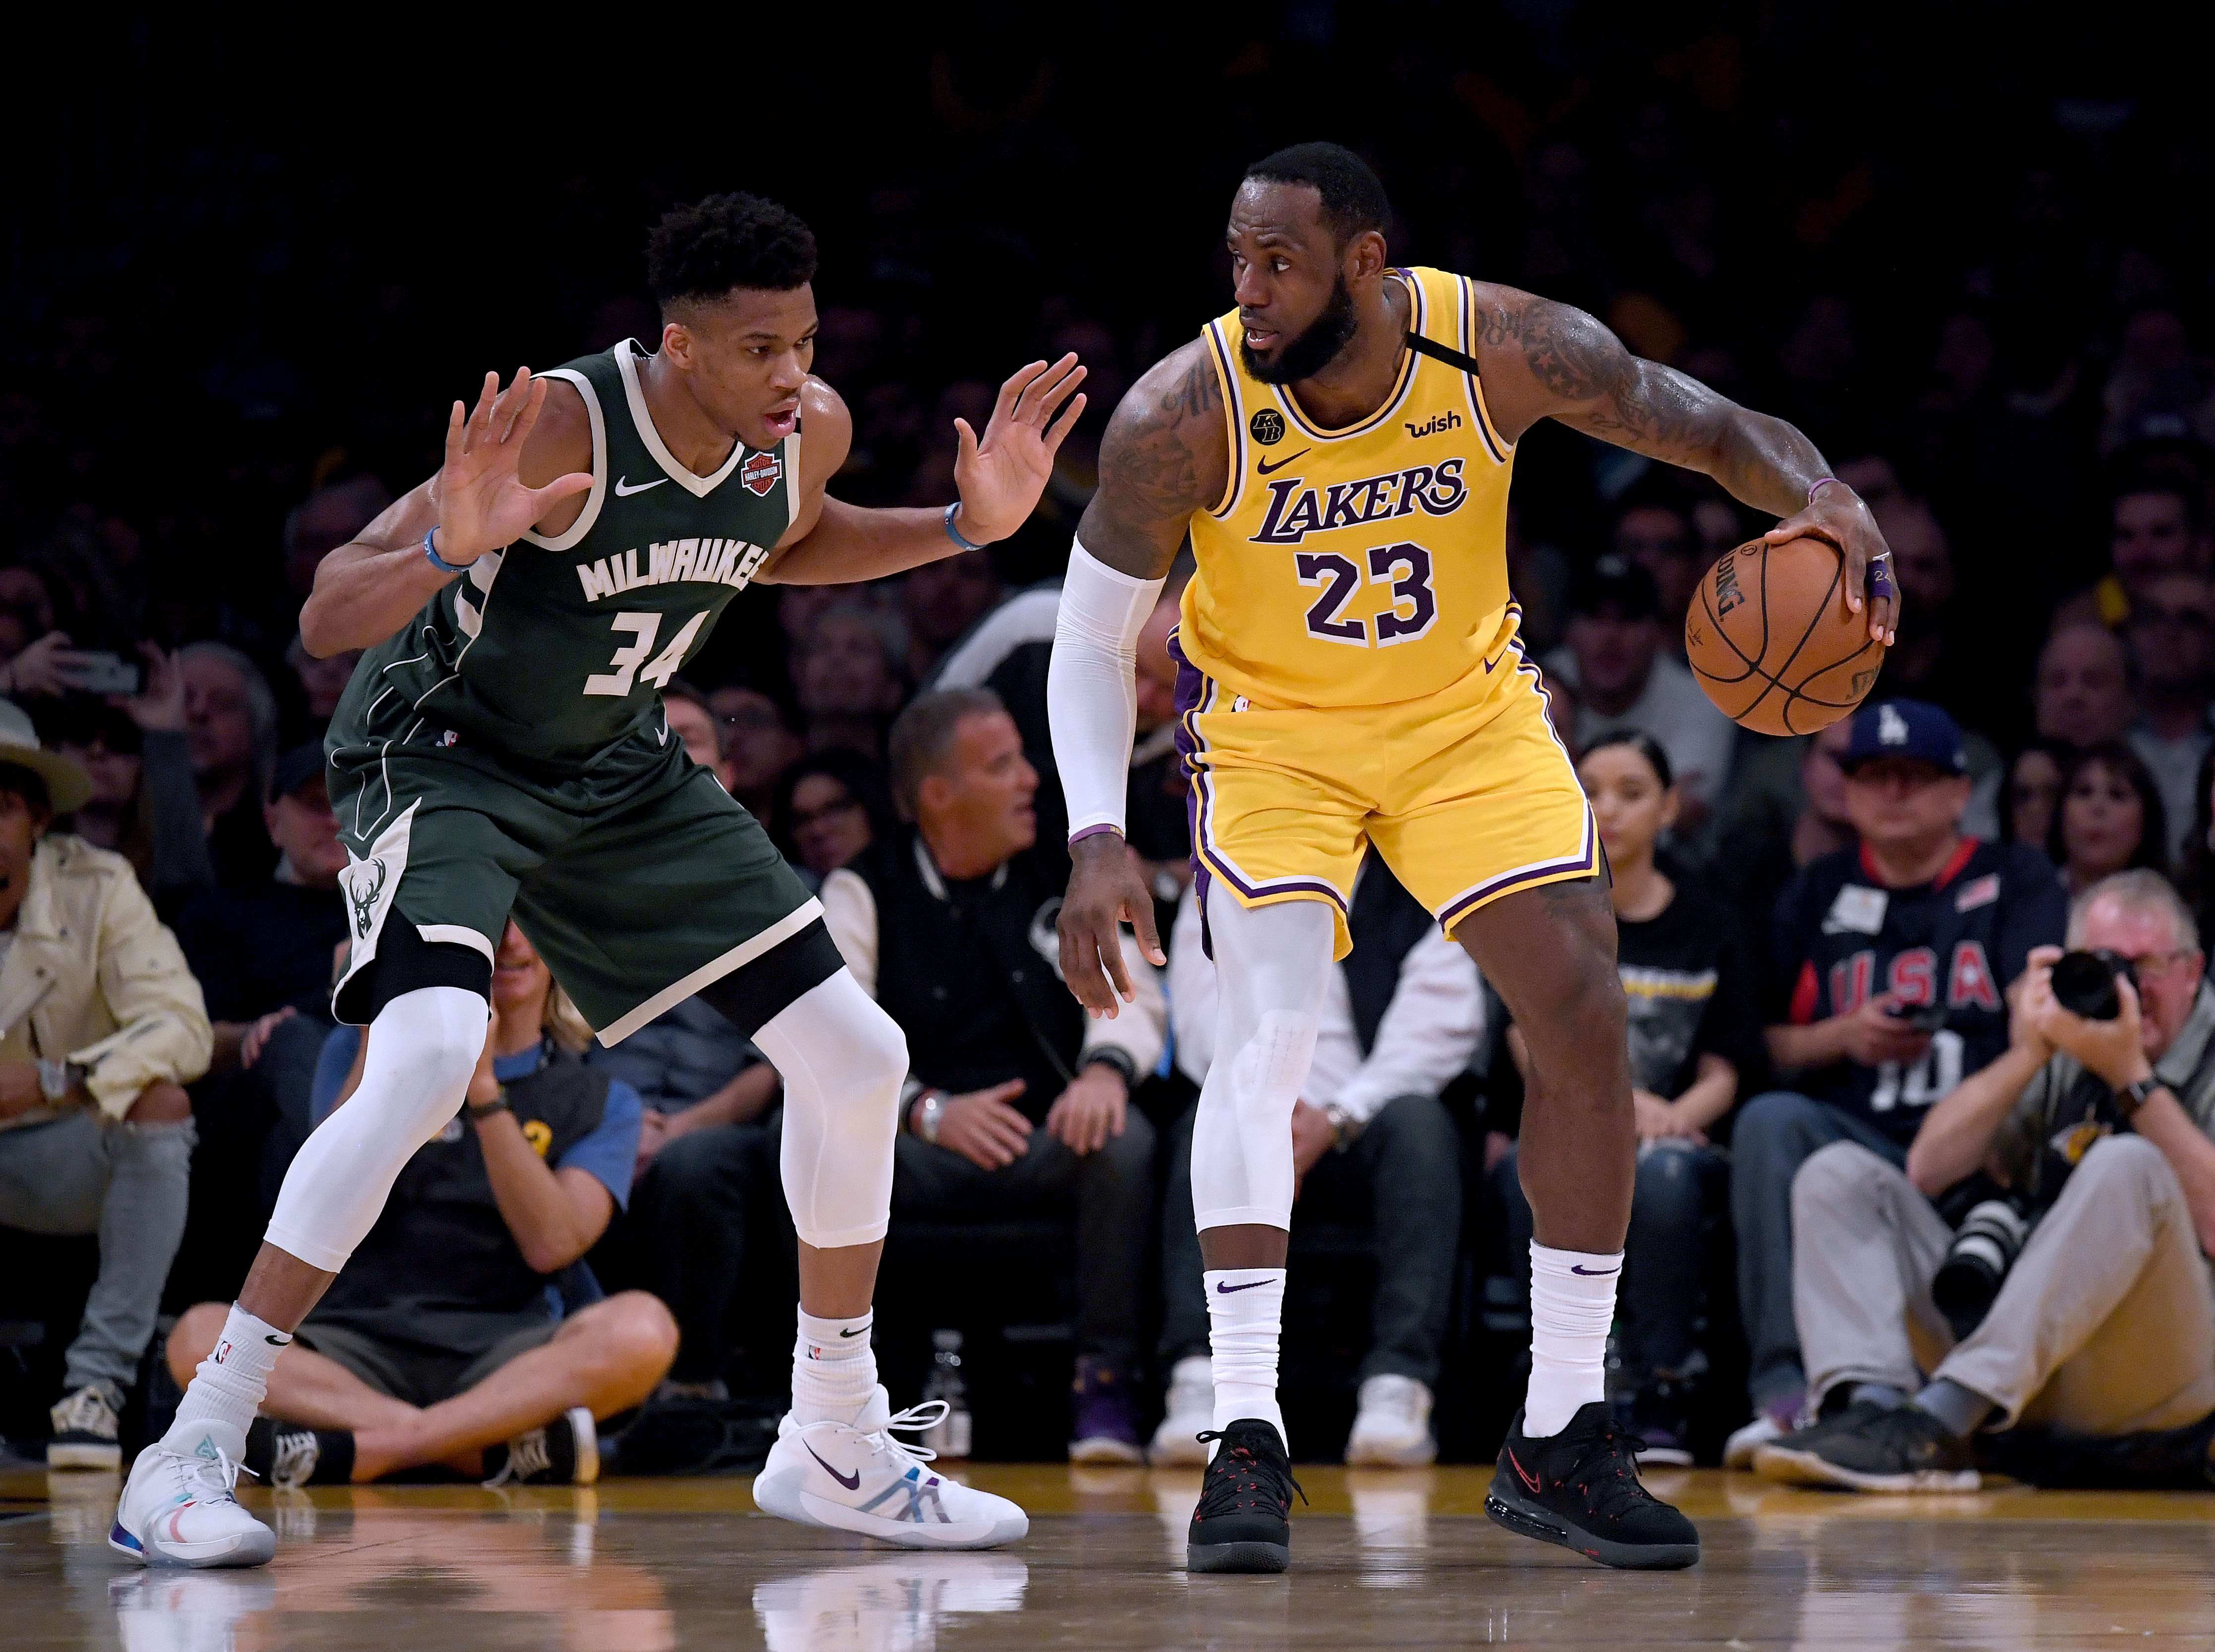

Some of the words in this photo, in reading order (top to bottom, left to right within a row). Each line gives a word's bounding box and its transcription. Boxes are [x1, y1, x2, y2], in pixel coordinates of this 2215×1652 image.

[1404, 410, 1462, 439] wish
[1247, 457, 1470, 545] LAKERS
[1293, 540, 1440, 649] 23
[582, 609, 711, 697] 34
[1829, 939, 2002, 1015] USA
